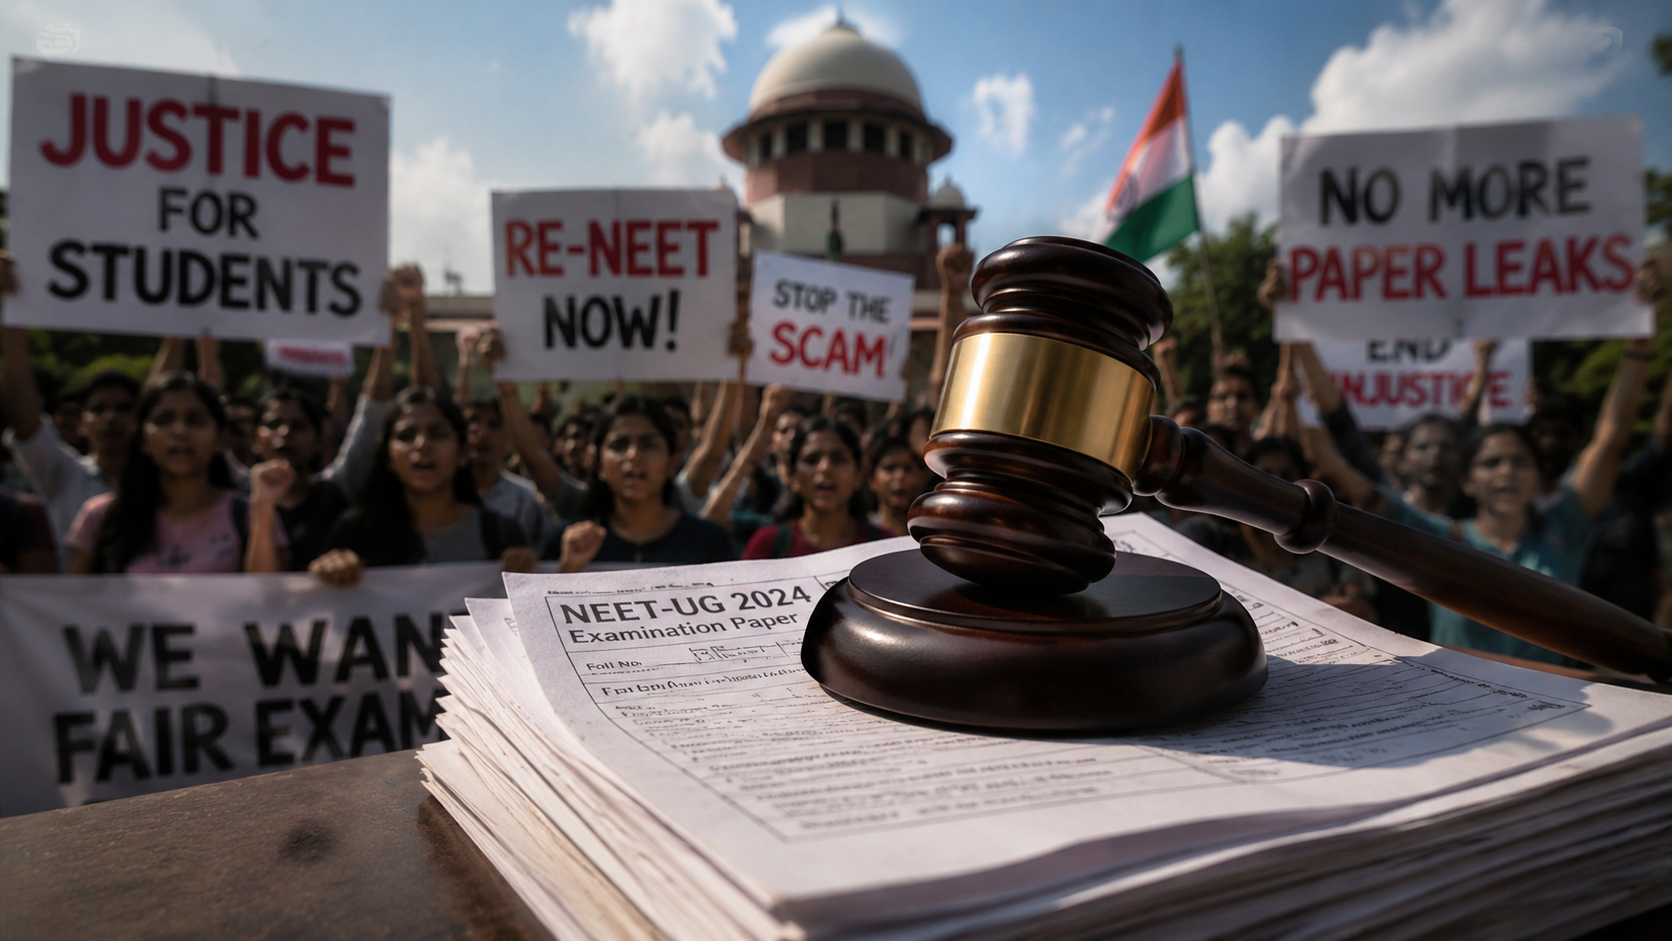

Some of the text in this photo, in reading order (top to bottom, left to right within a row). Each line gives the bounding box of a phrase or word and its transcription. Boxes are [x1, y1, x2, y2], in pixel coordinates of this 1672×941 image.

[39, 93, 356, 188] JUSTICE
[158, 186, 259, 238] FOR
[1319, 156, 1592, 227] NO MORE
[48, 239, 362, 318] STUDENTS
[506, 219, 720, 278] RE-NEET
[1287, 233, 1636, 304] PAPER LEAKS
[543, 288, 681, 352] NOW!
[772, 278, 892, 325] STOP THE
[1367, 337, 1451, 363] END
[560, 594, 726, 625] NEET-UG
[731, 584, 812, 612] 2024
[568, 611, 799, 644] Examination Paper
[62, 612, 471, 695] WE WAN
[52, 704, 236, 784] FAIR
